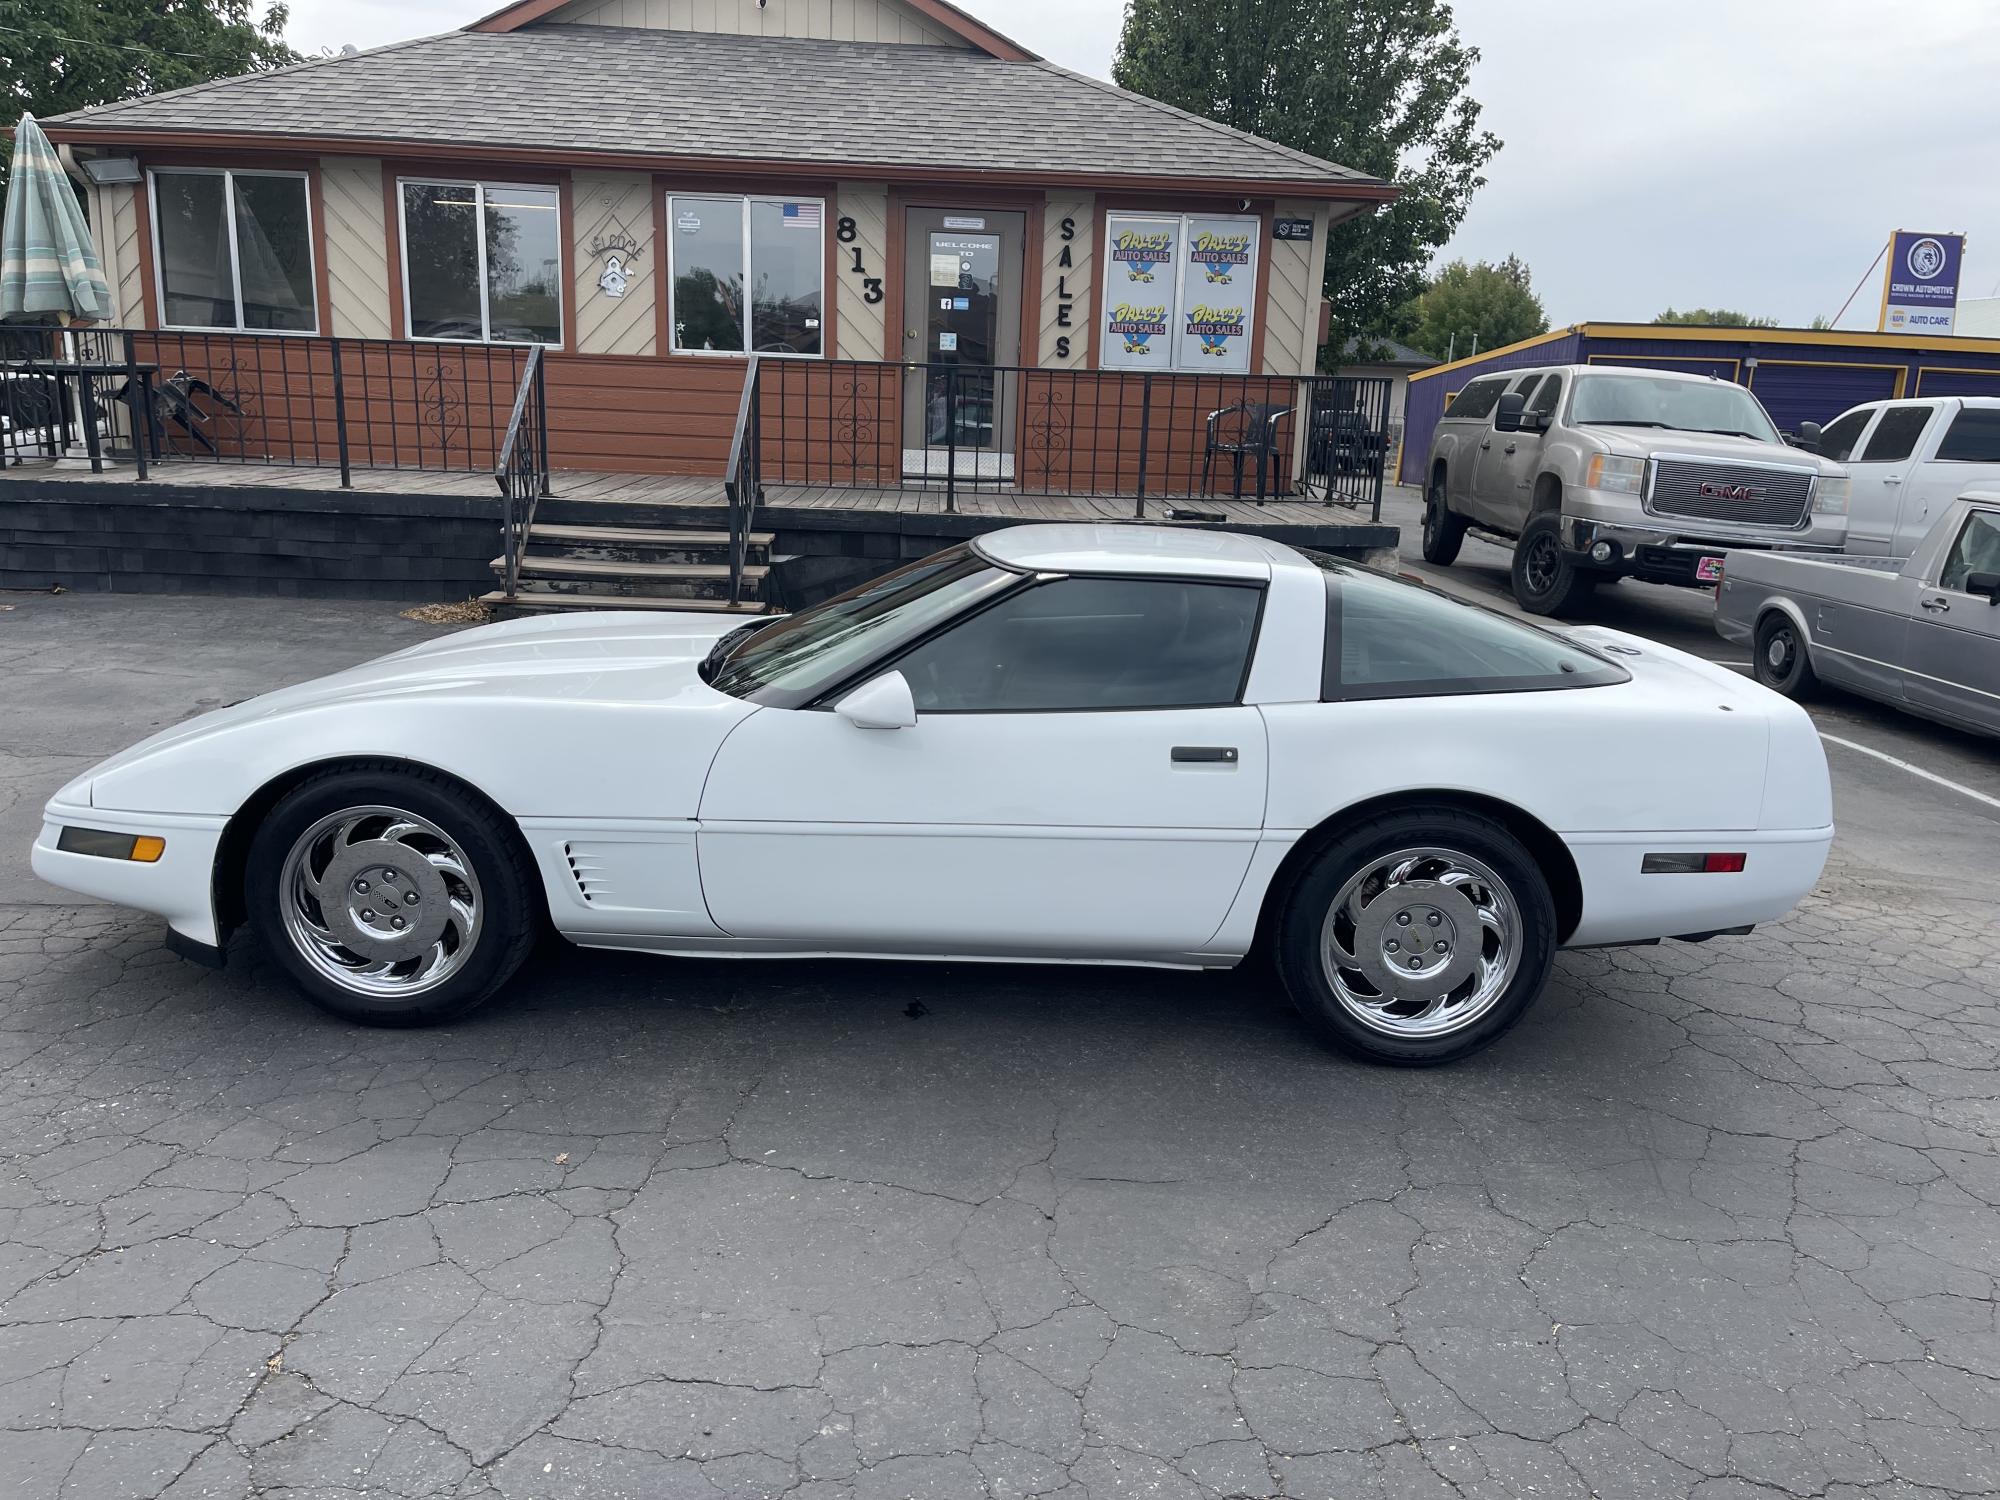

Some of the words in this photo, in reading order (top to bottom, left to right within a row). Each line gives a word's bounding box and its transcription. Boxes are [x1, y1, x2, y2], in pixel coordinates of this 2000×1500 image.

[935, 241, 993, 250] WELCOME
[837, 217, 883, 304] 813
[1114, 250, 1140, 261] AUTO
[1142, 251, 1169, 263] SALES
[1192, 252, 1219, 263] AUTO
[1220, 253, 1248, 264] SALES
[1056, 217, 1075, 358] SALES
[1892, 284, 1915, 293] CROWN
[1915, 285, 1955, 295] AUTOMOTIVE
[1909, 315, 1928, 325] AUTO
[1929, 316, 1950, 326] CARE
[1110, 322, 1137, 333] AUTO
[1138, 323, 1166, 334] SALES
[1187, 324, 1214, 335] AUTO
[1215, 325, 1242, 336] SALES
[1700, 482, 1767, 502] GMC
